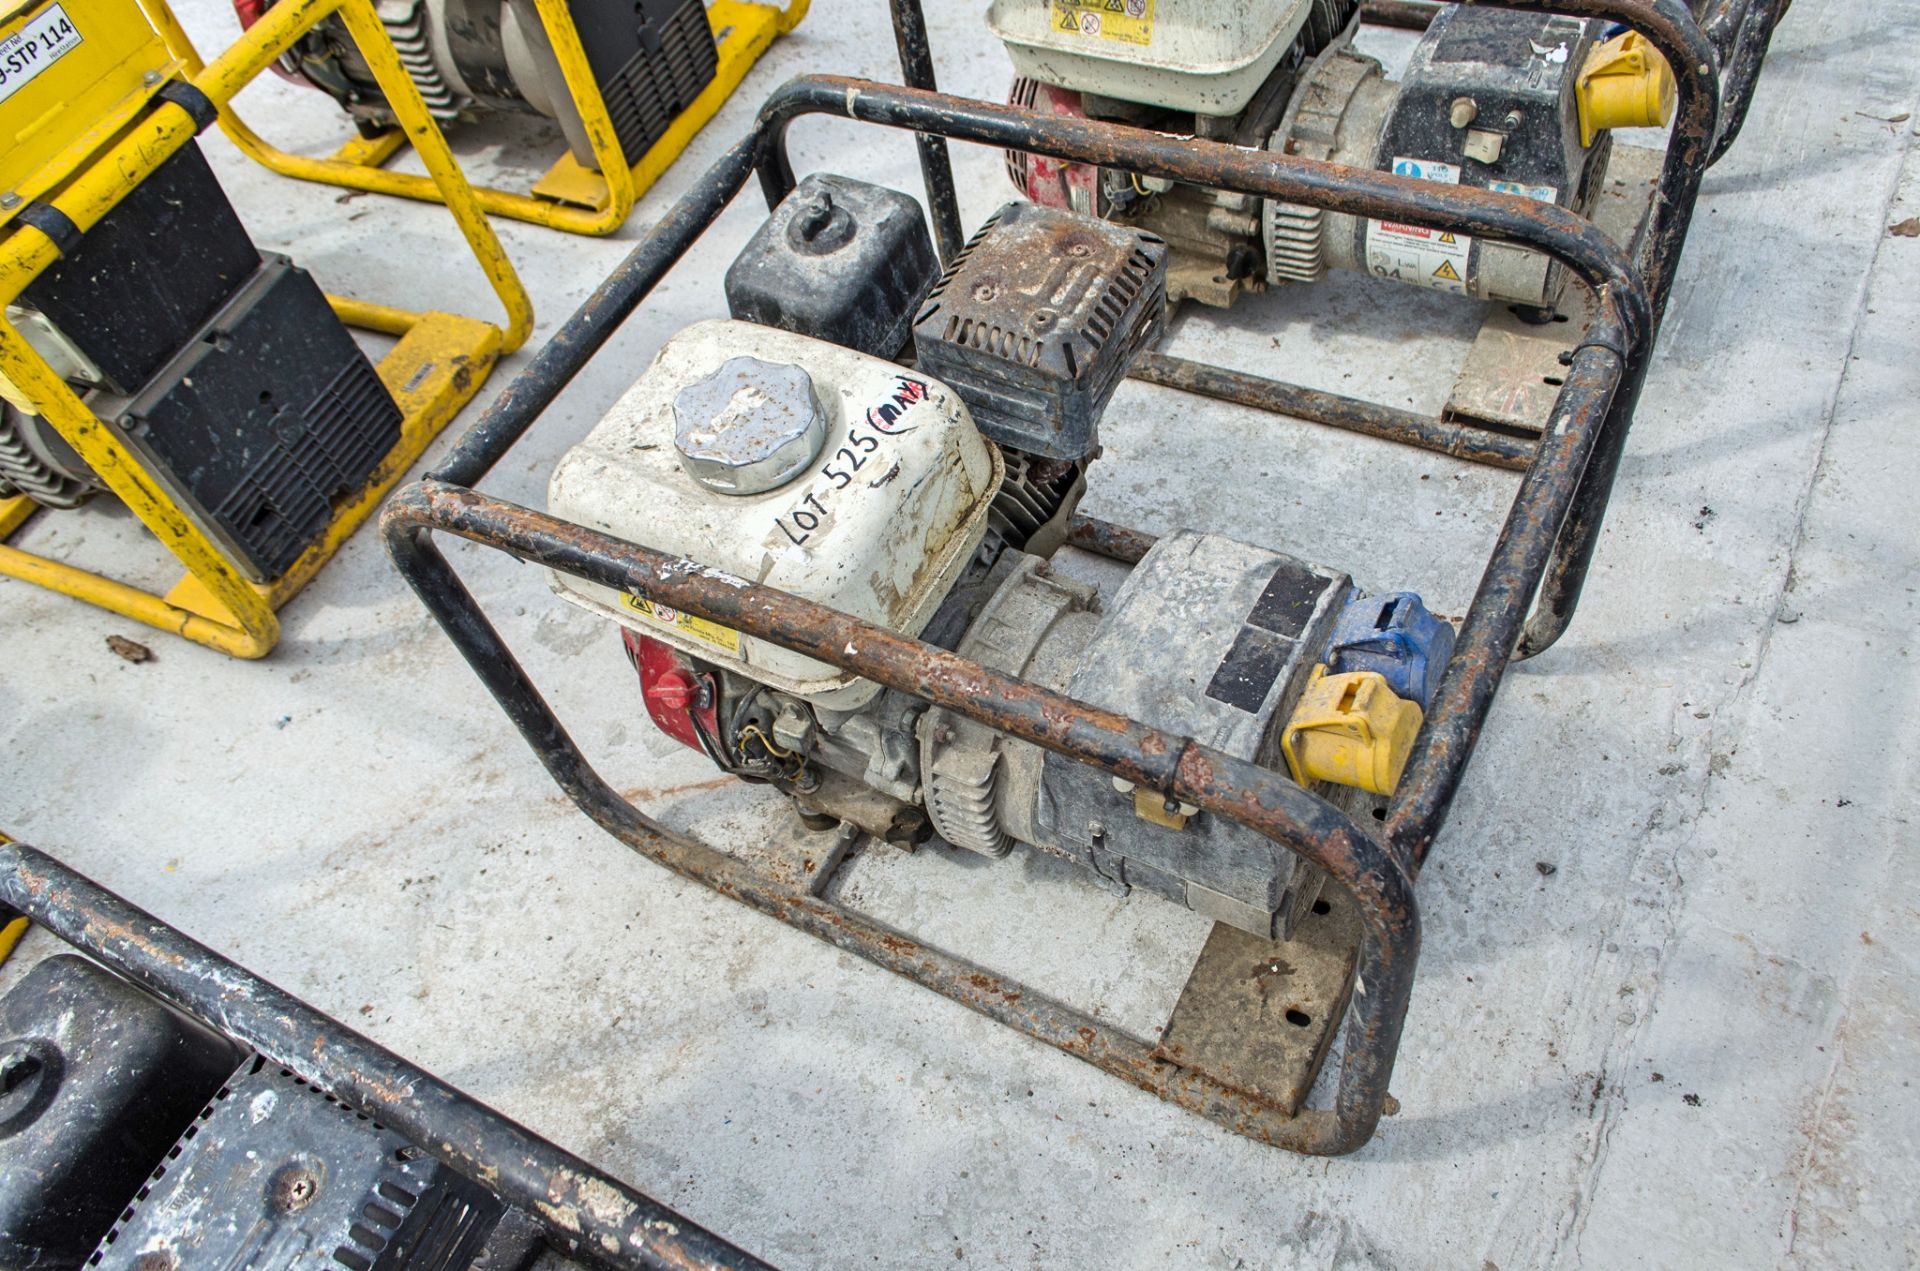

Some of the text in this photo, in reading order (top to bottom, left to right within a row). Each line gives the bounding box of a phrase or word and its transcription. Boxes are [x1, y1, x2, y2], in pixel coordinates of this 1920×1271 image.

[40, 18, 72, 50] 114
[774, 492, 828, 546] LOT
[822, 429, 879, 490] 525
